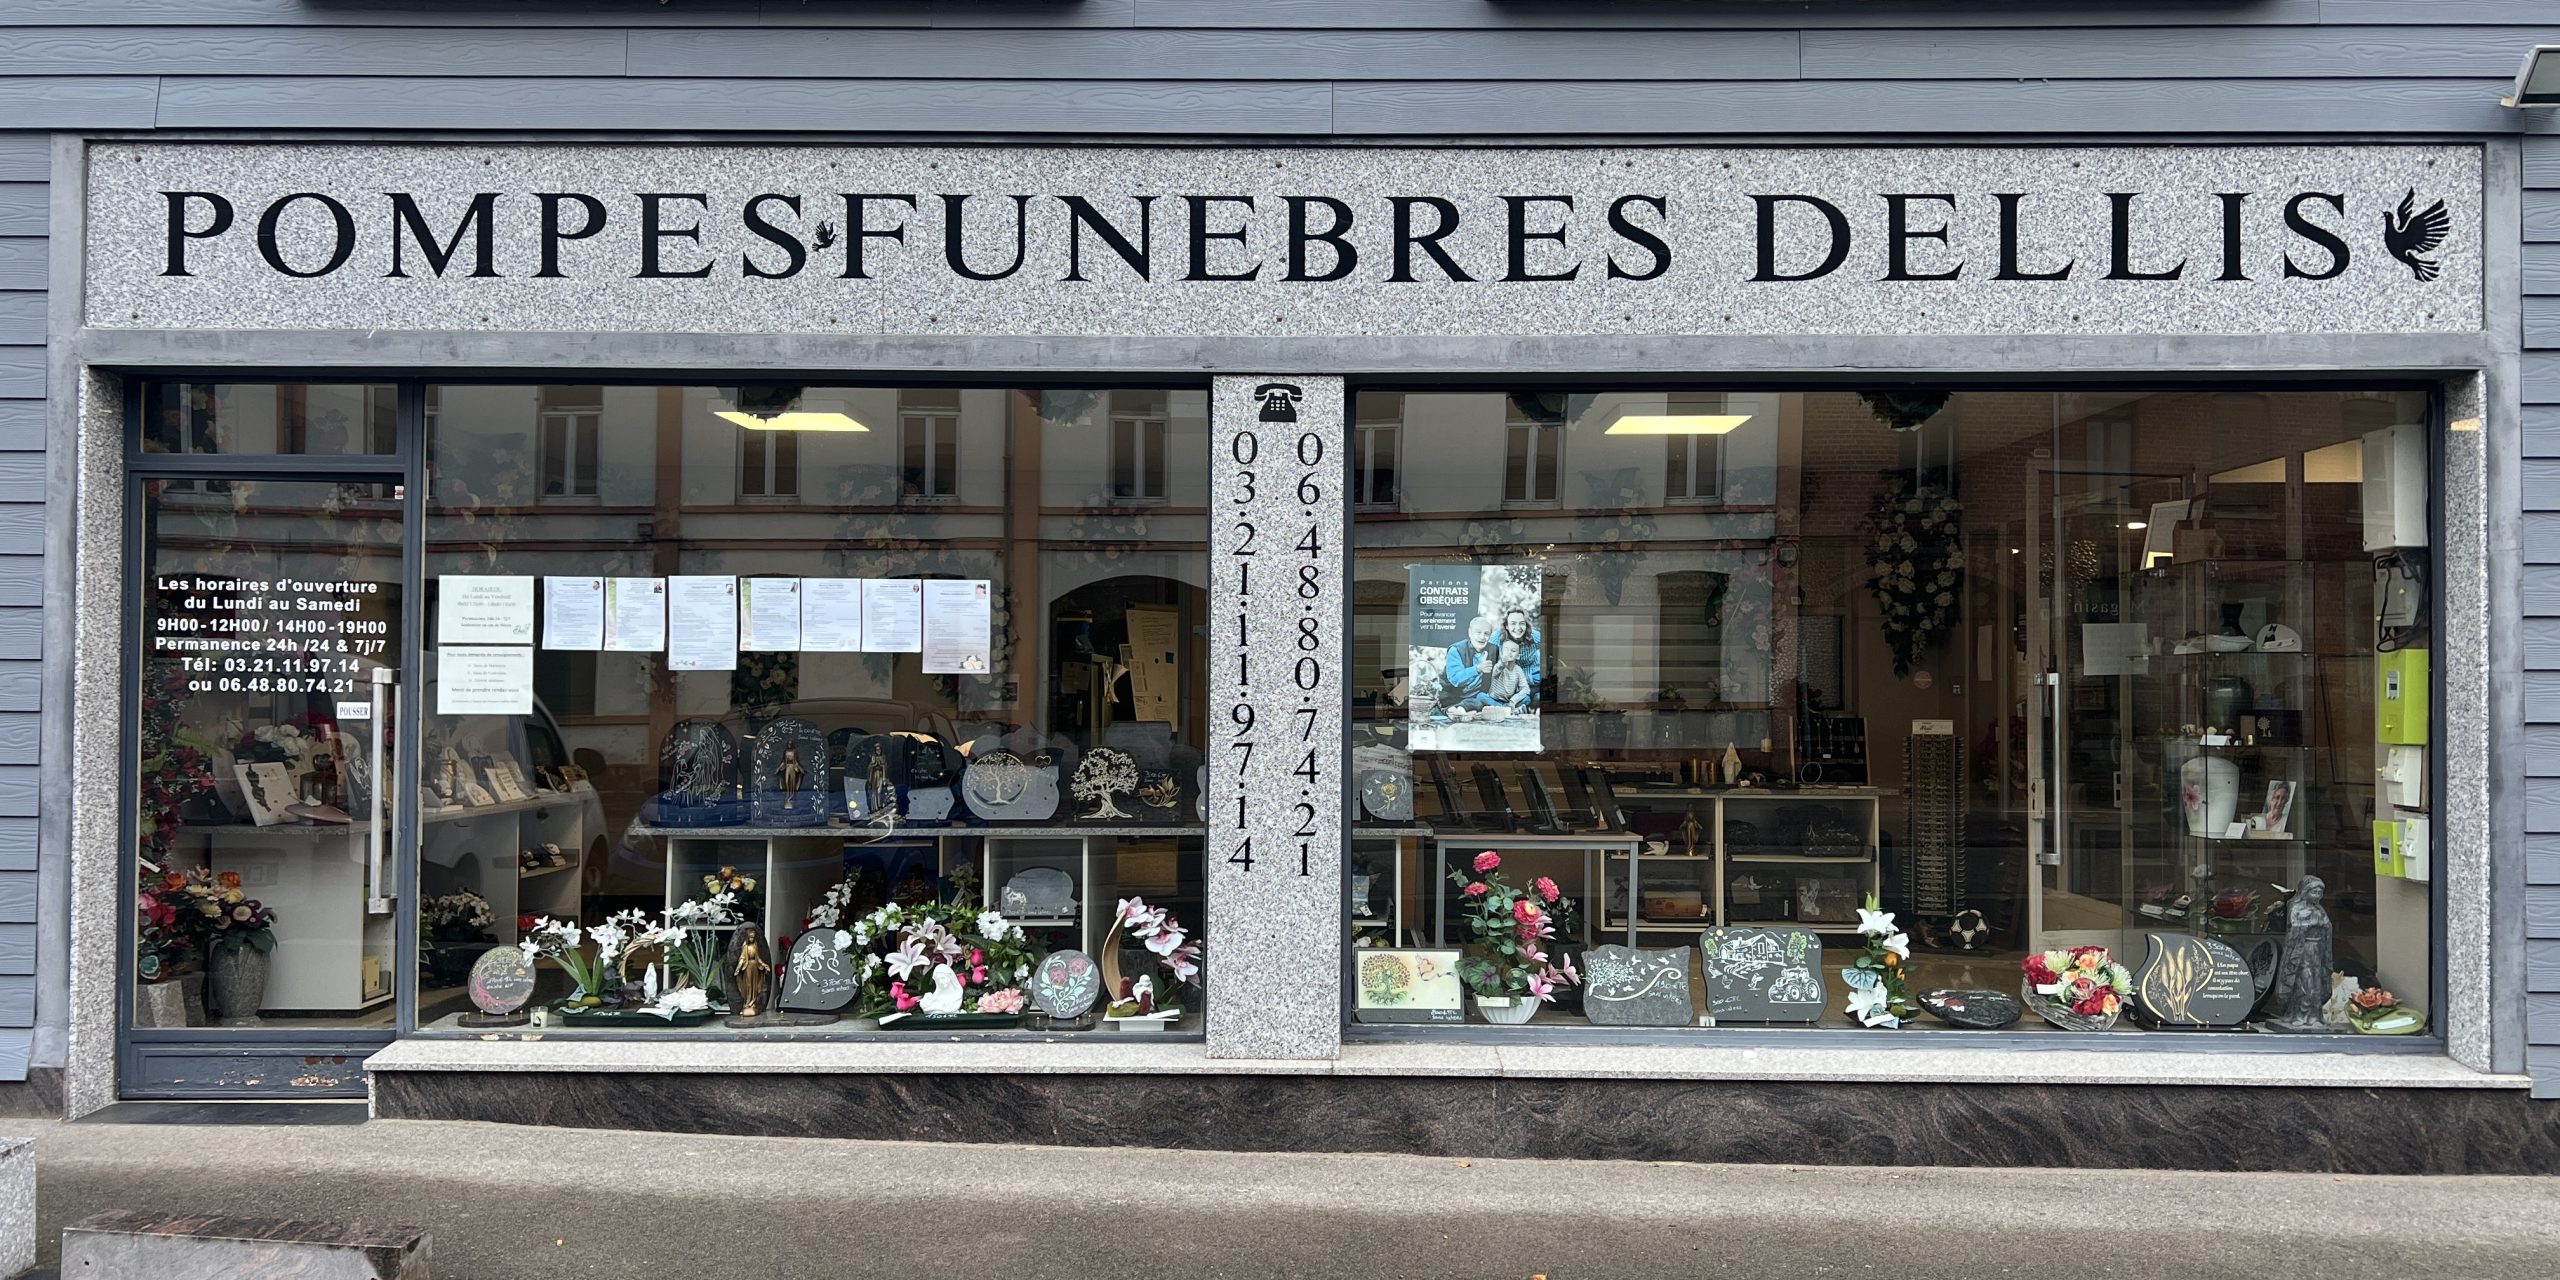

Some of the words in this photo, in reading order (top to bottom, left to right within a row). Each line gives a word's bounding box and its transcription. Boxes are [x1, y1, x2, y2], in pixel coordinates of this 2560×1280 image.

[157, 191, 808, 280] POMPES
[835, 192, 1672, 283] FUNEBRES
[1745, 190, 2351, 282] DELLIS
[158, 577, 189, 591] Les
[196, 577, 269, 592] horaires
[276, 578, 378, 594] d'ouverture
[1420, 587, 1469, 595] CONTRATS
[184, 596, 206, 609] du
[213, 596, 263, 610] Lundi
[269, 600, 290, 610] au
[296, 597, 361, 612] Samedi
[1420, 595, 1469, 606] OBSÈQUES
[155, 637, 261, 651] Permanence
[266, 639, 298, 652] 24h
[336, 640, 349, 653] &
[355, 639, 386, 656] 7j/7
[181, 657, 217, 672] Tél:
[224, 658, 360, 673] 03.21.11.97.14
[188, 681, 212, 692] ou
[219, 678, 354, 693] 06.48.80.74.21
[339, 706, 369, 717] POUSSER
